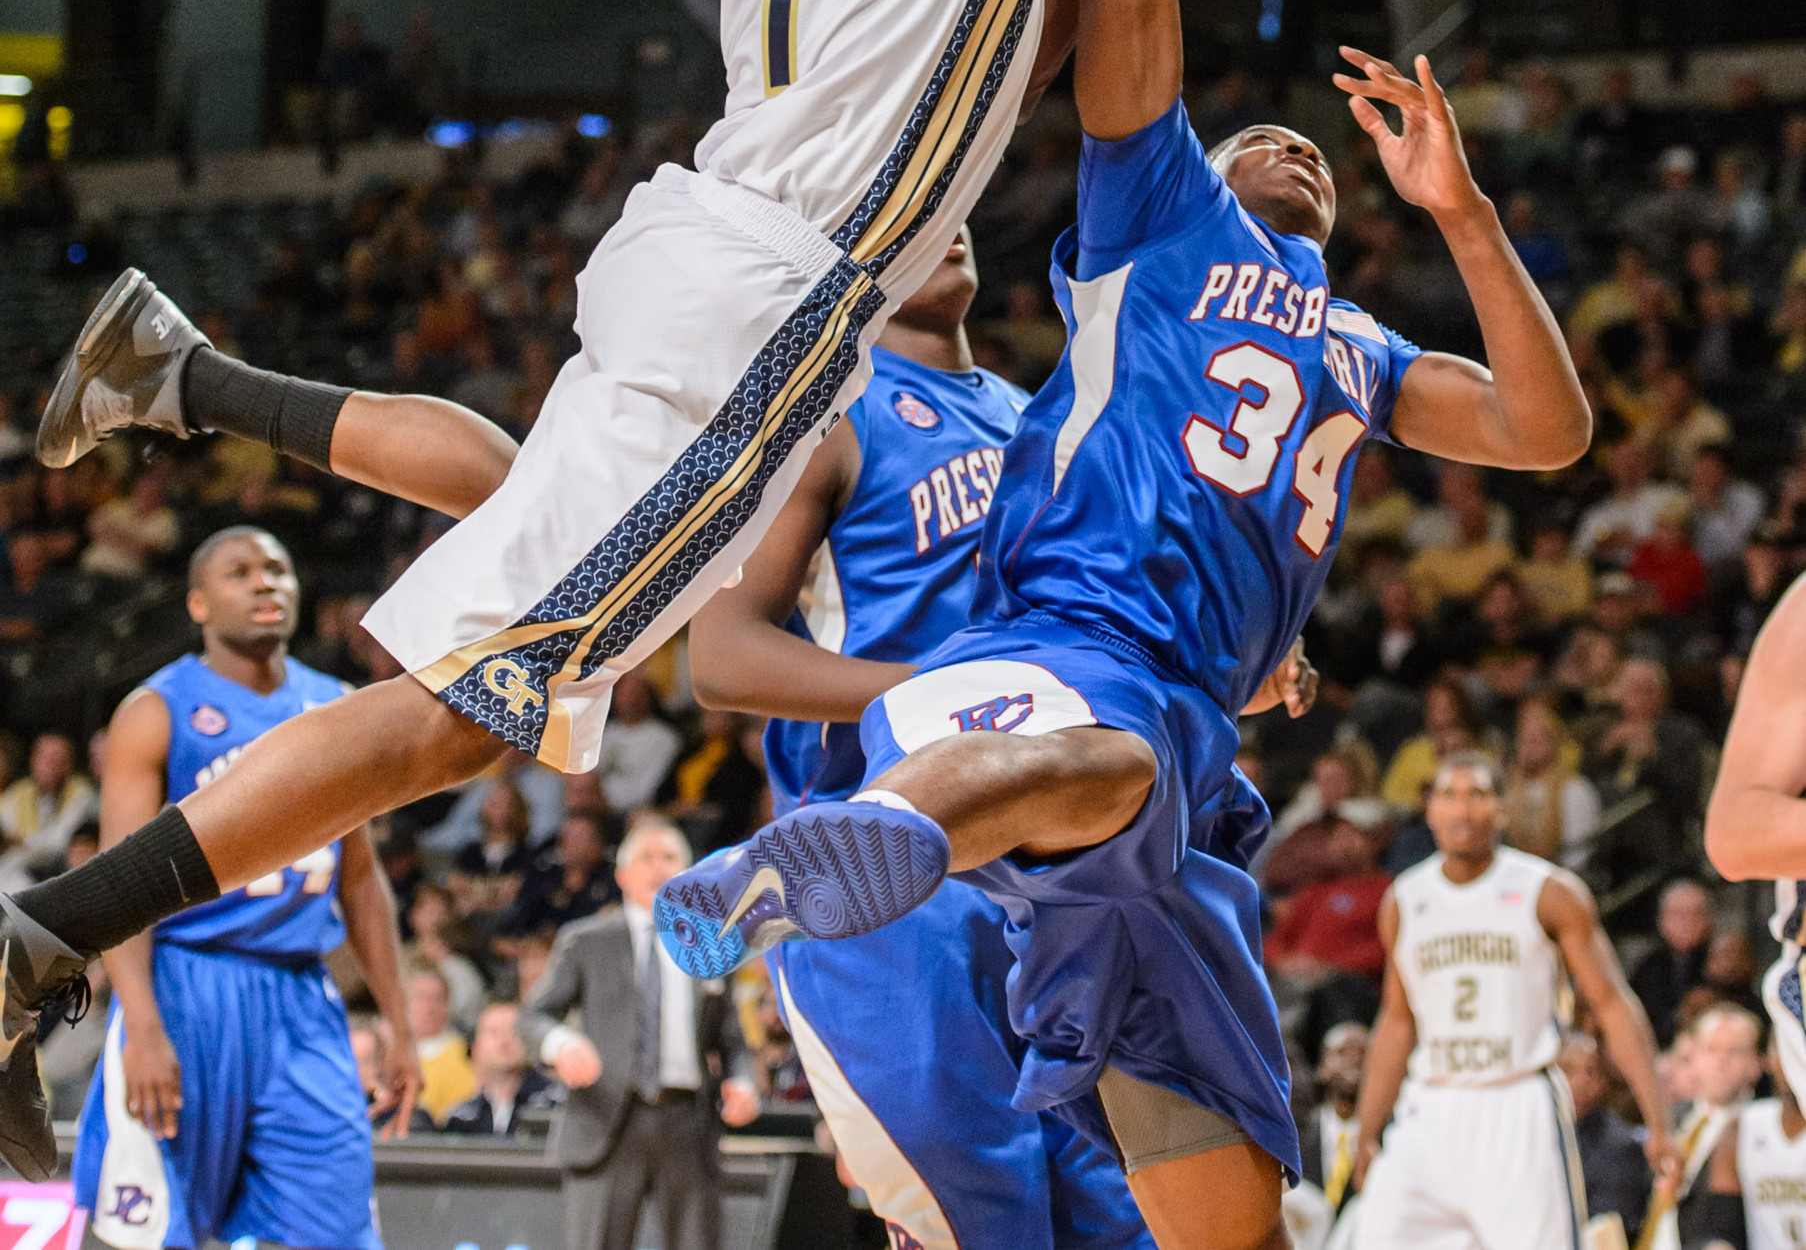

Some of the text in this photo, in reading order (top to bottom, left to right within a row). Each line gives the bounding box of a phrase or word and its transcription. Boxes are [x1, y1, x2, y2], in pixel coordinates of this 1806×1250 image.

[1181, 339, 1370, 562] 34
[483, 658, 545, 717] GT
[1453, 975, 1479, 1022] 2
